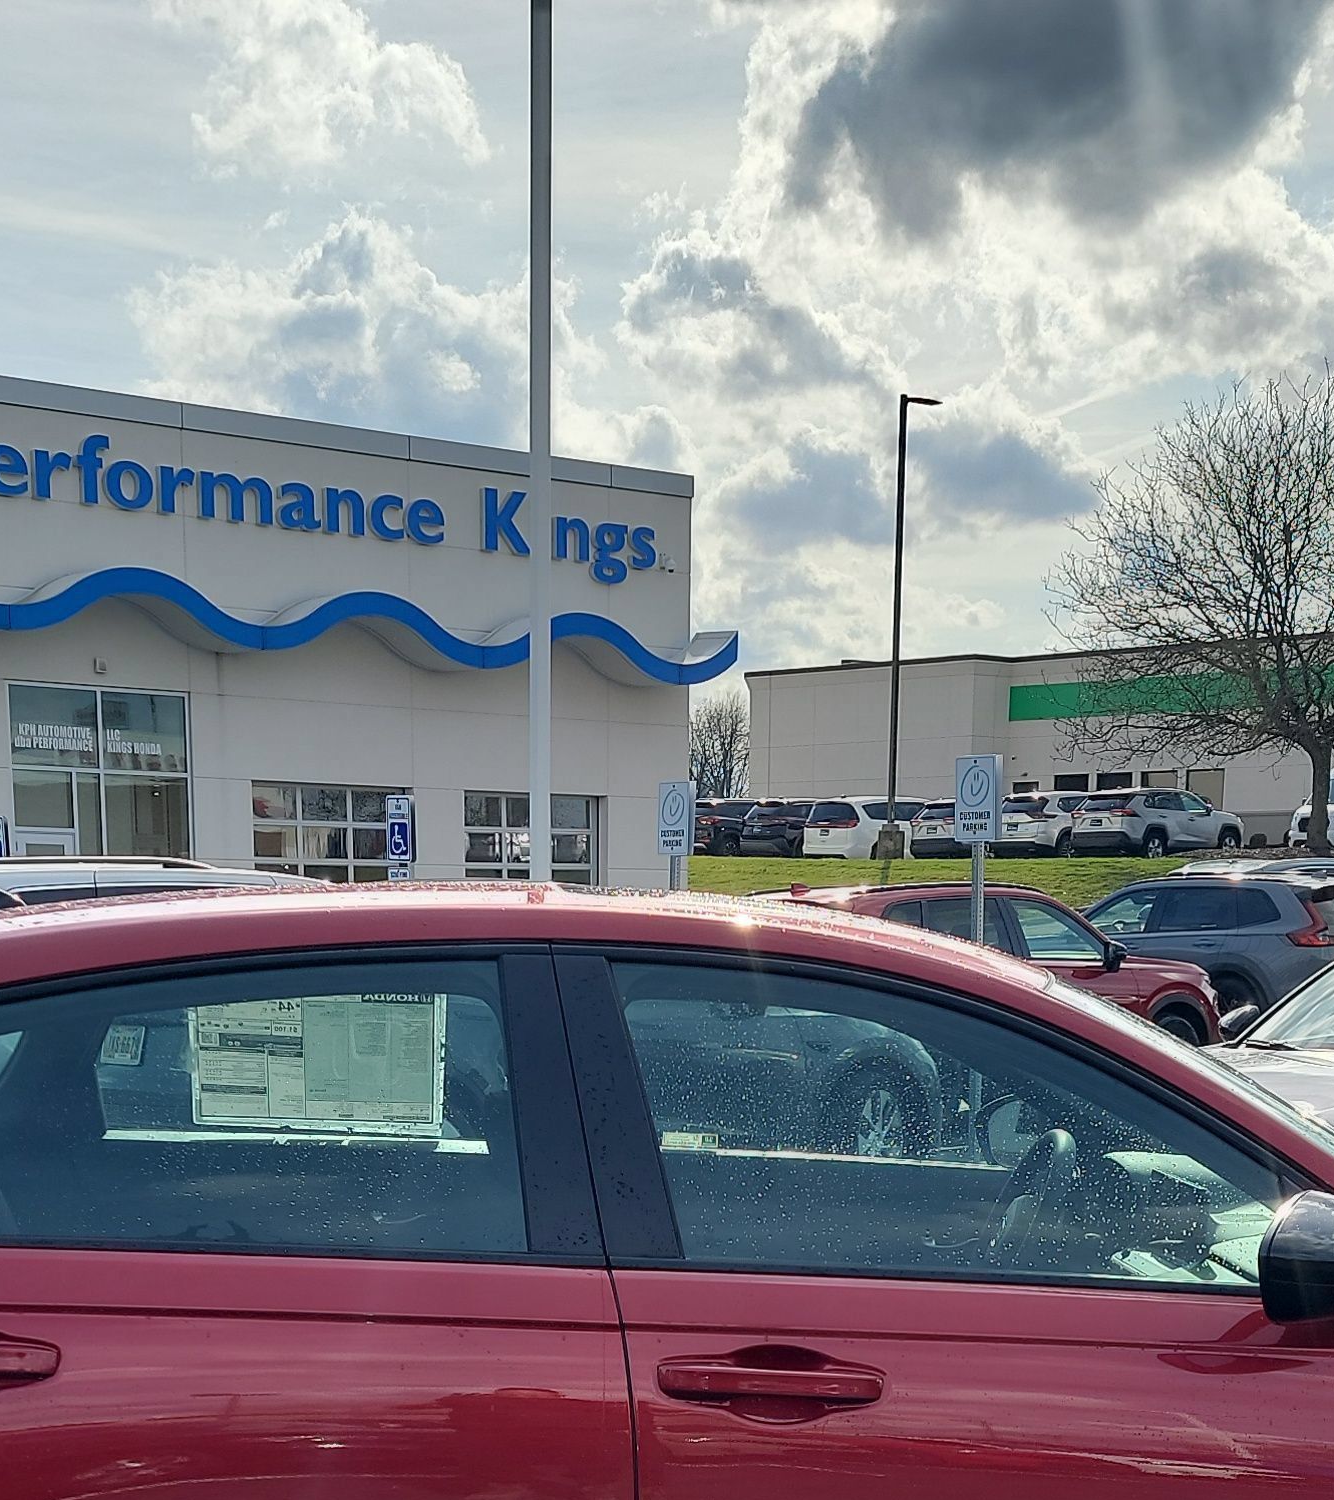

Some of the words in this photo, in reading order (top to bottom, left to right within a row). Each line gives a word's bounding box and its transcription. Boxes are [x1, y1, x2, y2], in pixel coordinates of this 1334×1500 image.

[481, 486, 657, 584] Kngs
[18, 723, 36, 736] KPH
[107, 729, 120, 741] LLC
[15, 735, 31, 748] dba
[33, 737, 93, 752] PERFORMANCE
[107, 741, 132, 754] KINGS
[134, 742, 162, 756] HONDA
[959, 811, 990, 820] CUSTOMER
[963, 822, 987, 831] PARKING
